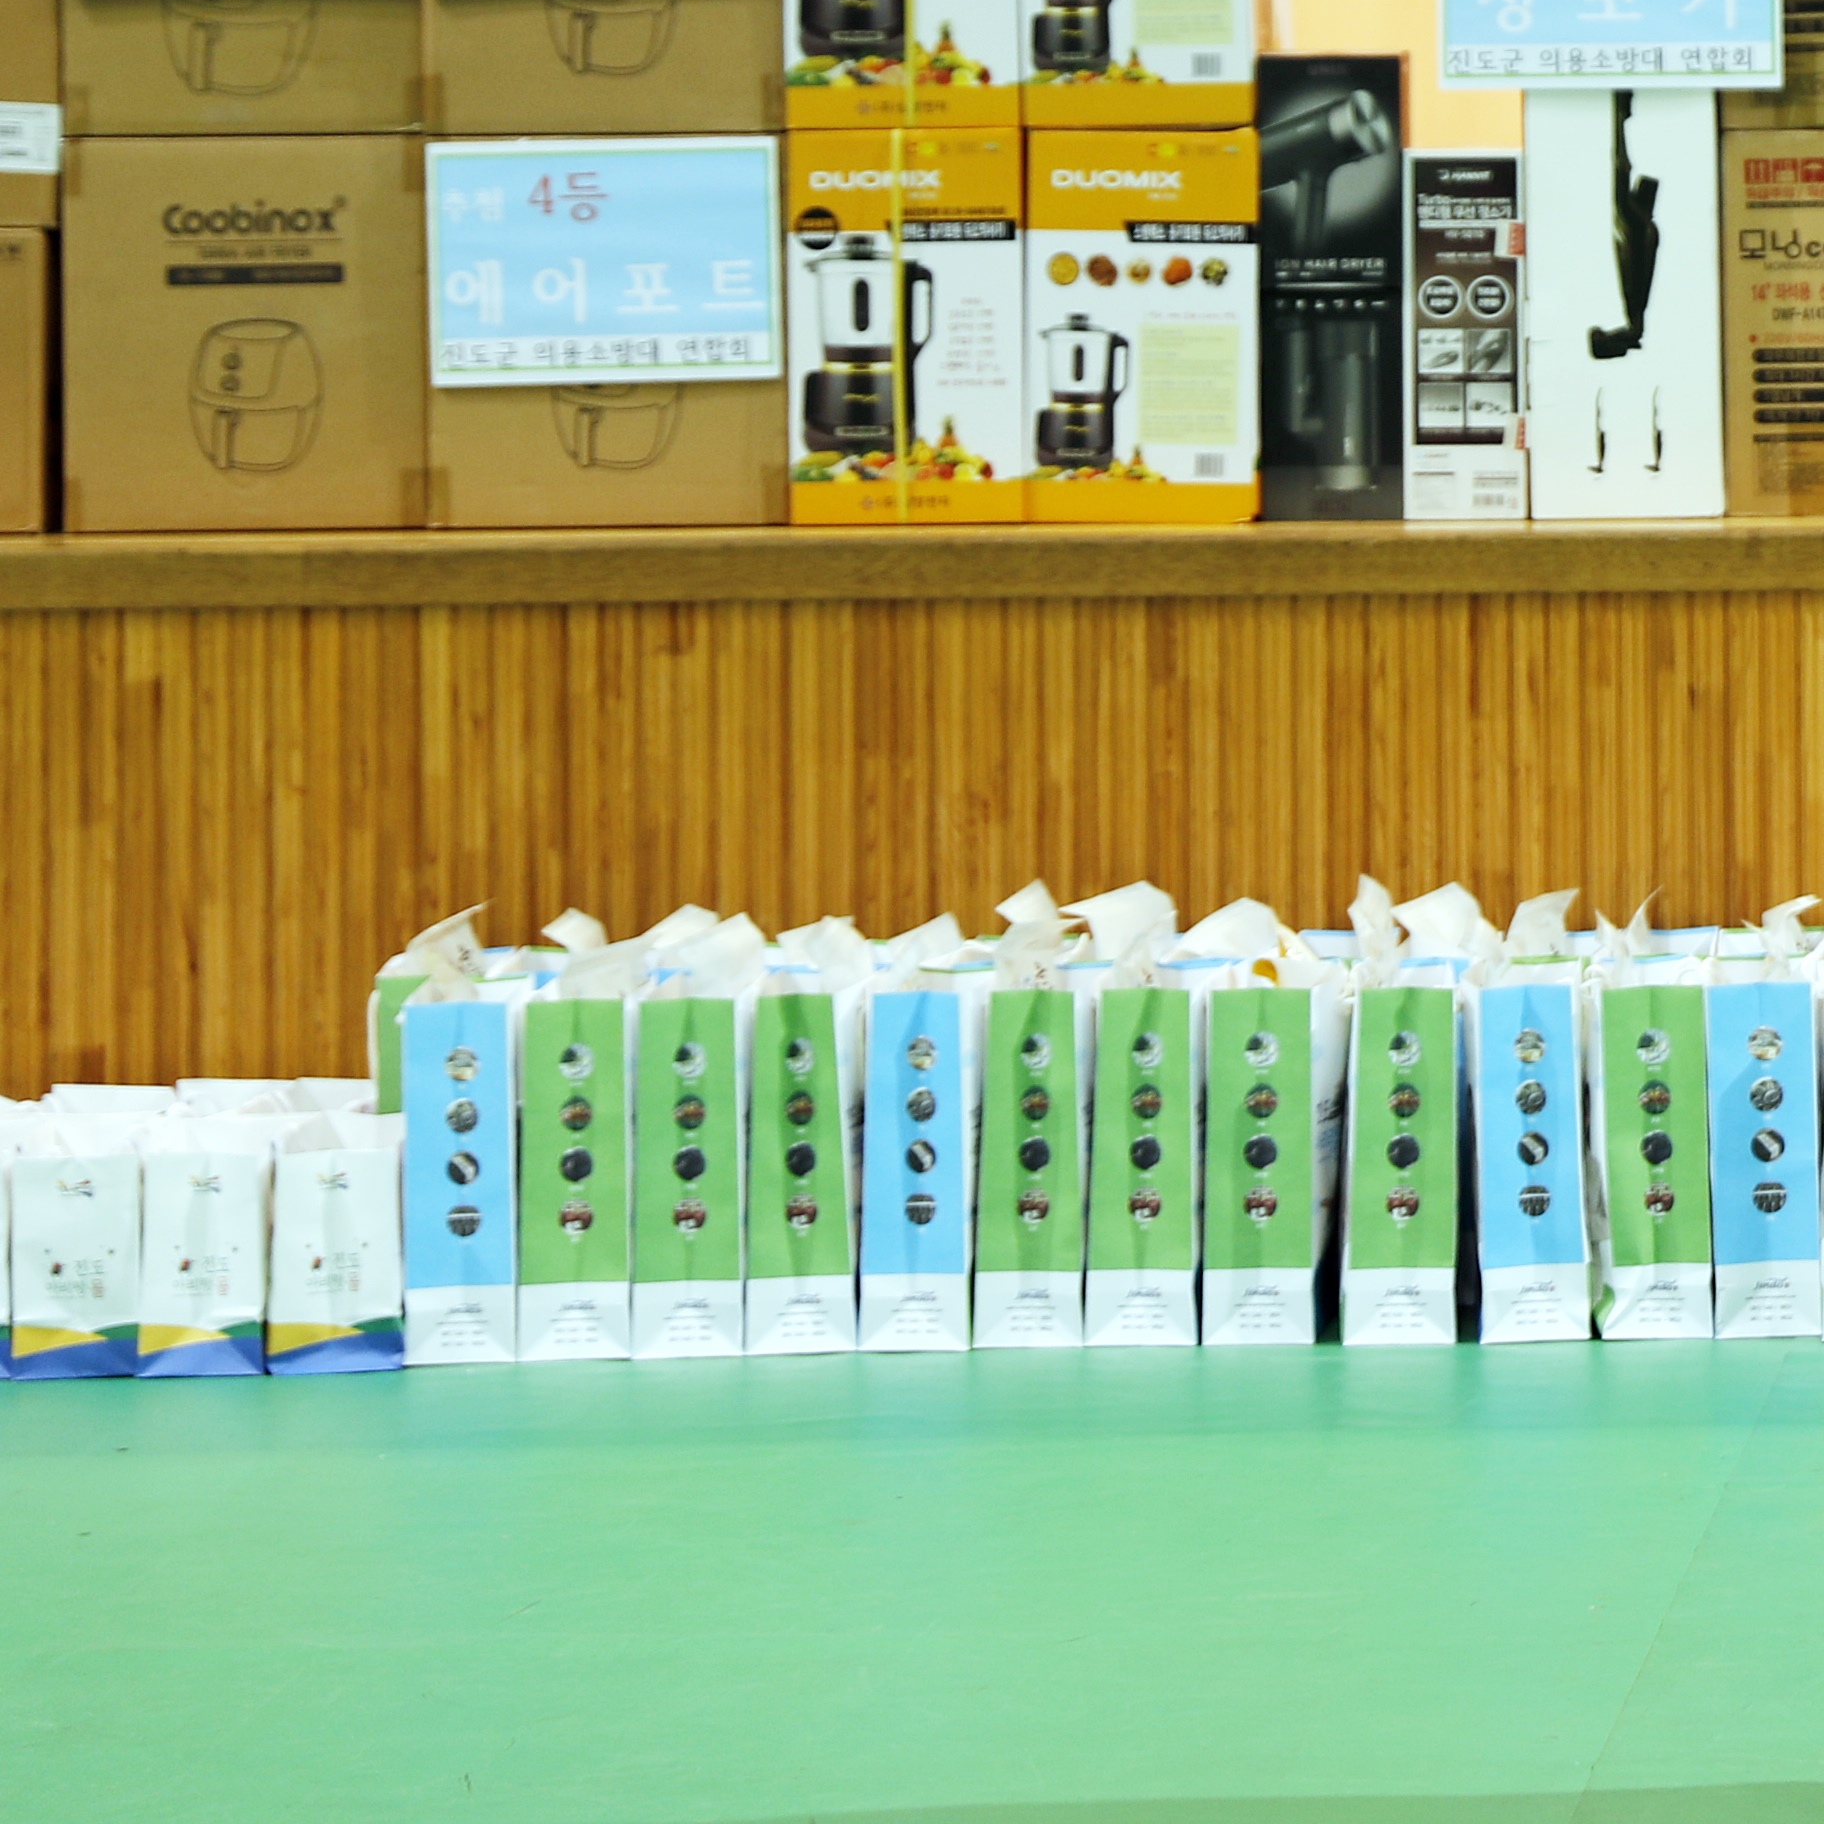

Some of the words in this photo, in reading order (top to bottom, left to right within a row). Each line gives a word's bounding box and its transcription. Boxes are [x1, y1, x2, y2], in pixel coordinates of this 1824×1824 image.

[1448, 49, 1524, 74] 진도군
[1539, 47, 1664, 73] 의용소방대
[1680, 46, 1753, 72] 연합회
[528, 172, 609, 222] 4등
[1050, 169, 1183, 191] DUOMIX
[445, 257, 765, 326] 에어포트
[439, 341, 517, 371] 진도군
[532, 339, 659, 368] 의용소방대
[675, 337, 749, 366] 연합회
